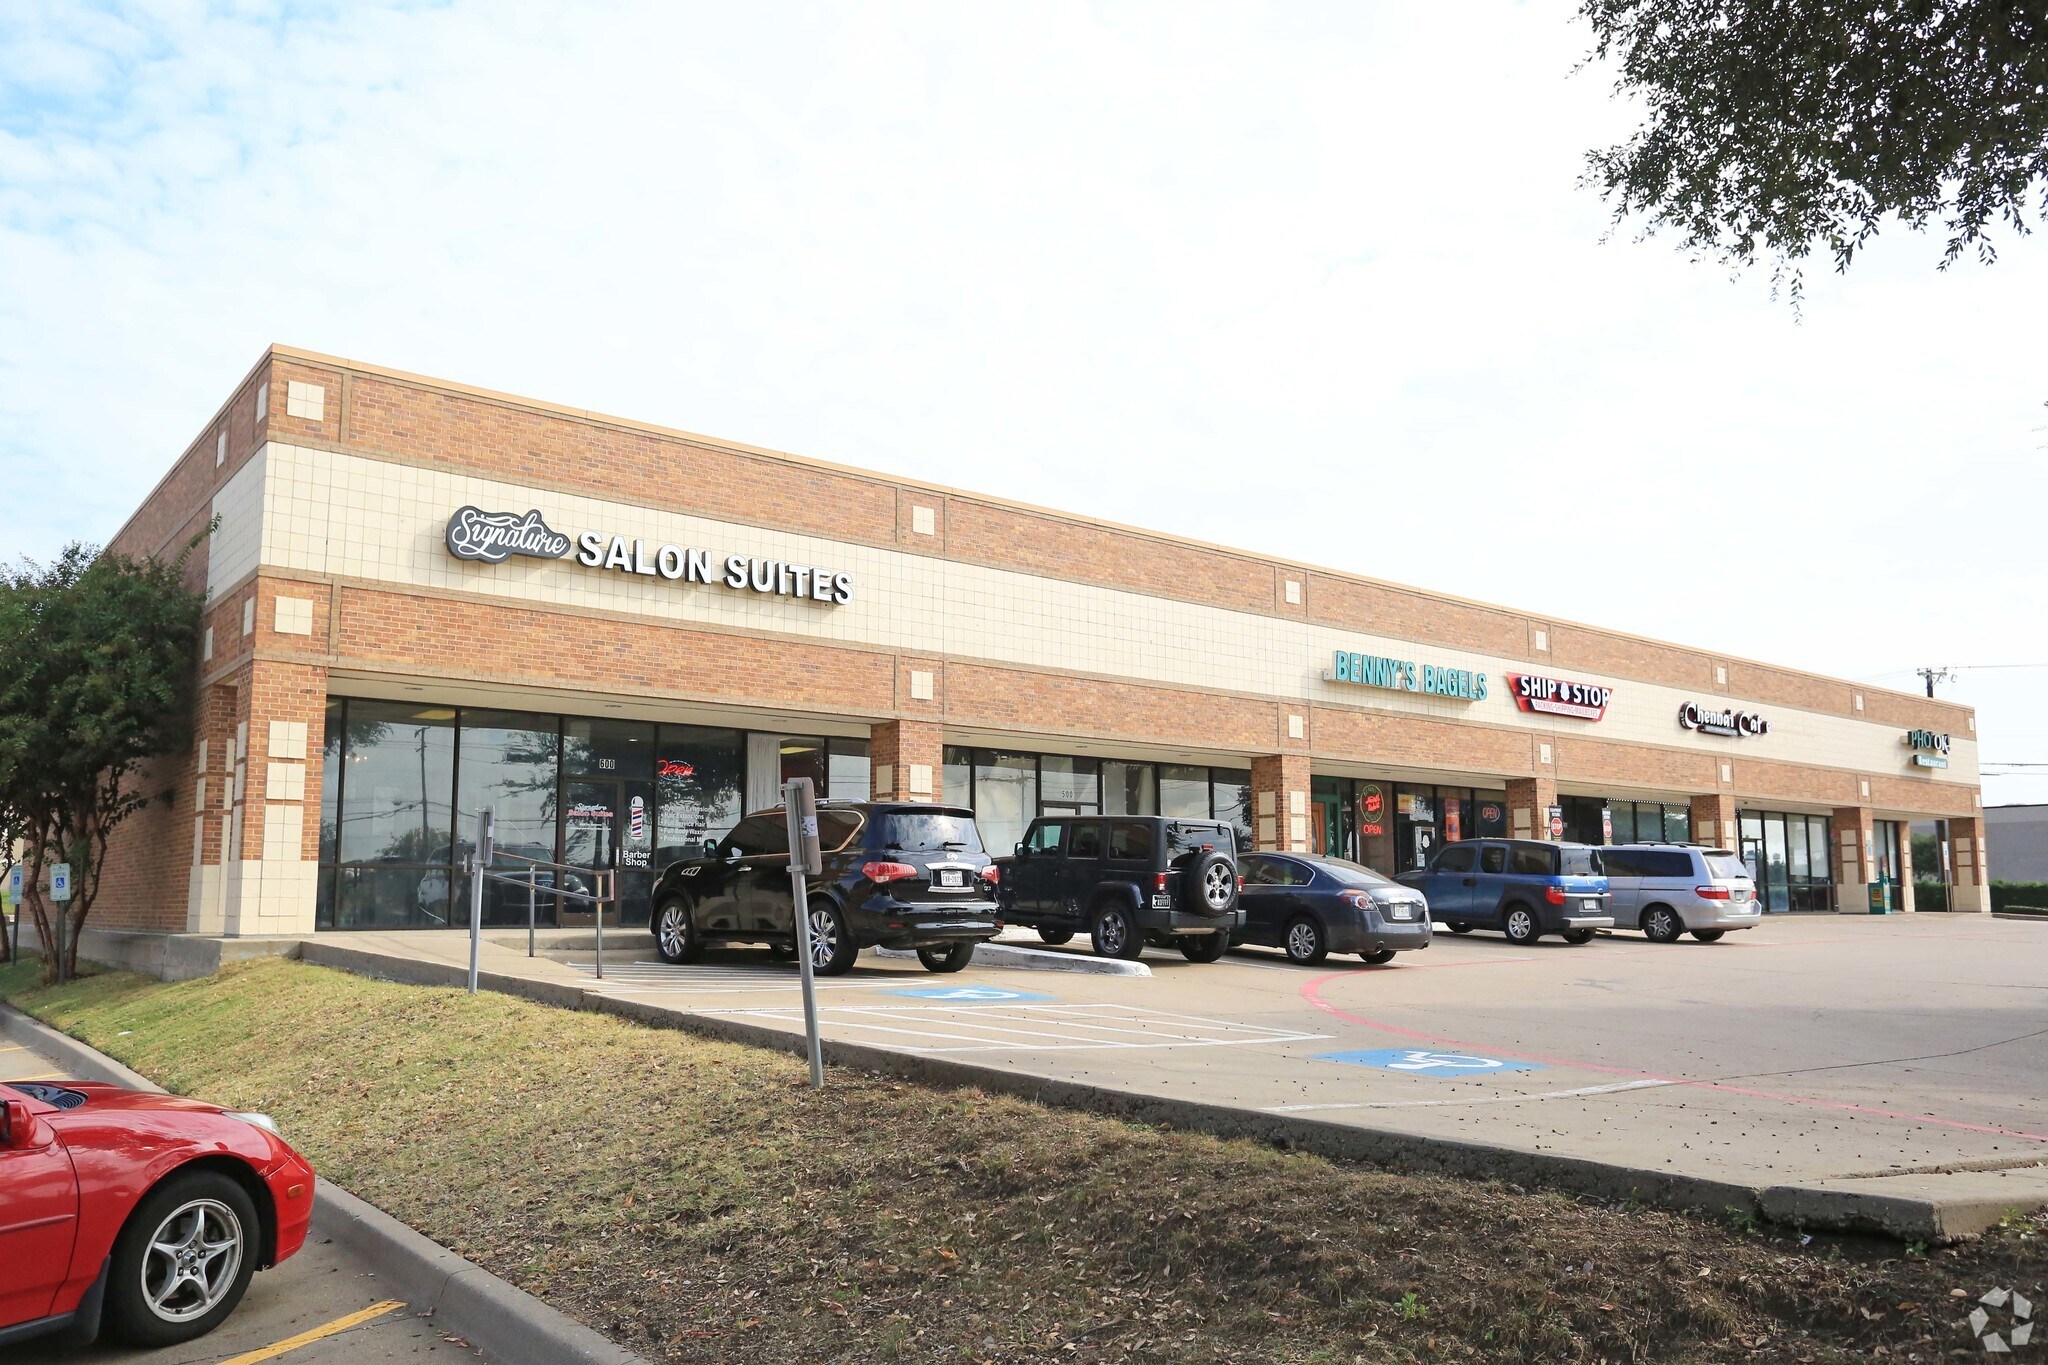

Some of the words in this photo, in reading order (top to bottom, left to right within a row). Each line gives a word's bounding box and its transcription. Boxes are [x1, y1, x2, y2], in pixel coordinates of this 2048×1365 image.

[451, 509, 567, 559] Signature
[577, 529, 713, 585] SALON
[724, 554, 855, 605] SUITES
[1335, 650, 1417, 690] BENNY'S
[1424, 664, 1488, 701] BAGELS
[1520, 676, 1556, 699] SHIP
[1573, 685, 1612, 708] STOP
[1685, 702, 1735, 728] Chennai
[1739, 711, 1773, 737] Cafe
[600, 759, 615, 769] 600
[1917, 755, 1947, 769] Restaurant
[1061, 790, 1074, 799] 500
[1482, 807, 1499, 819] OPEN
[1363, 824, 1382, 835] OPEN
[623, 850, 651, 859] Barber
[625, 858, 648, 868] Shop
